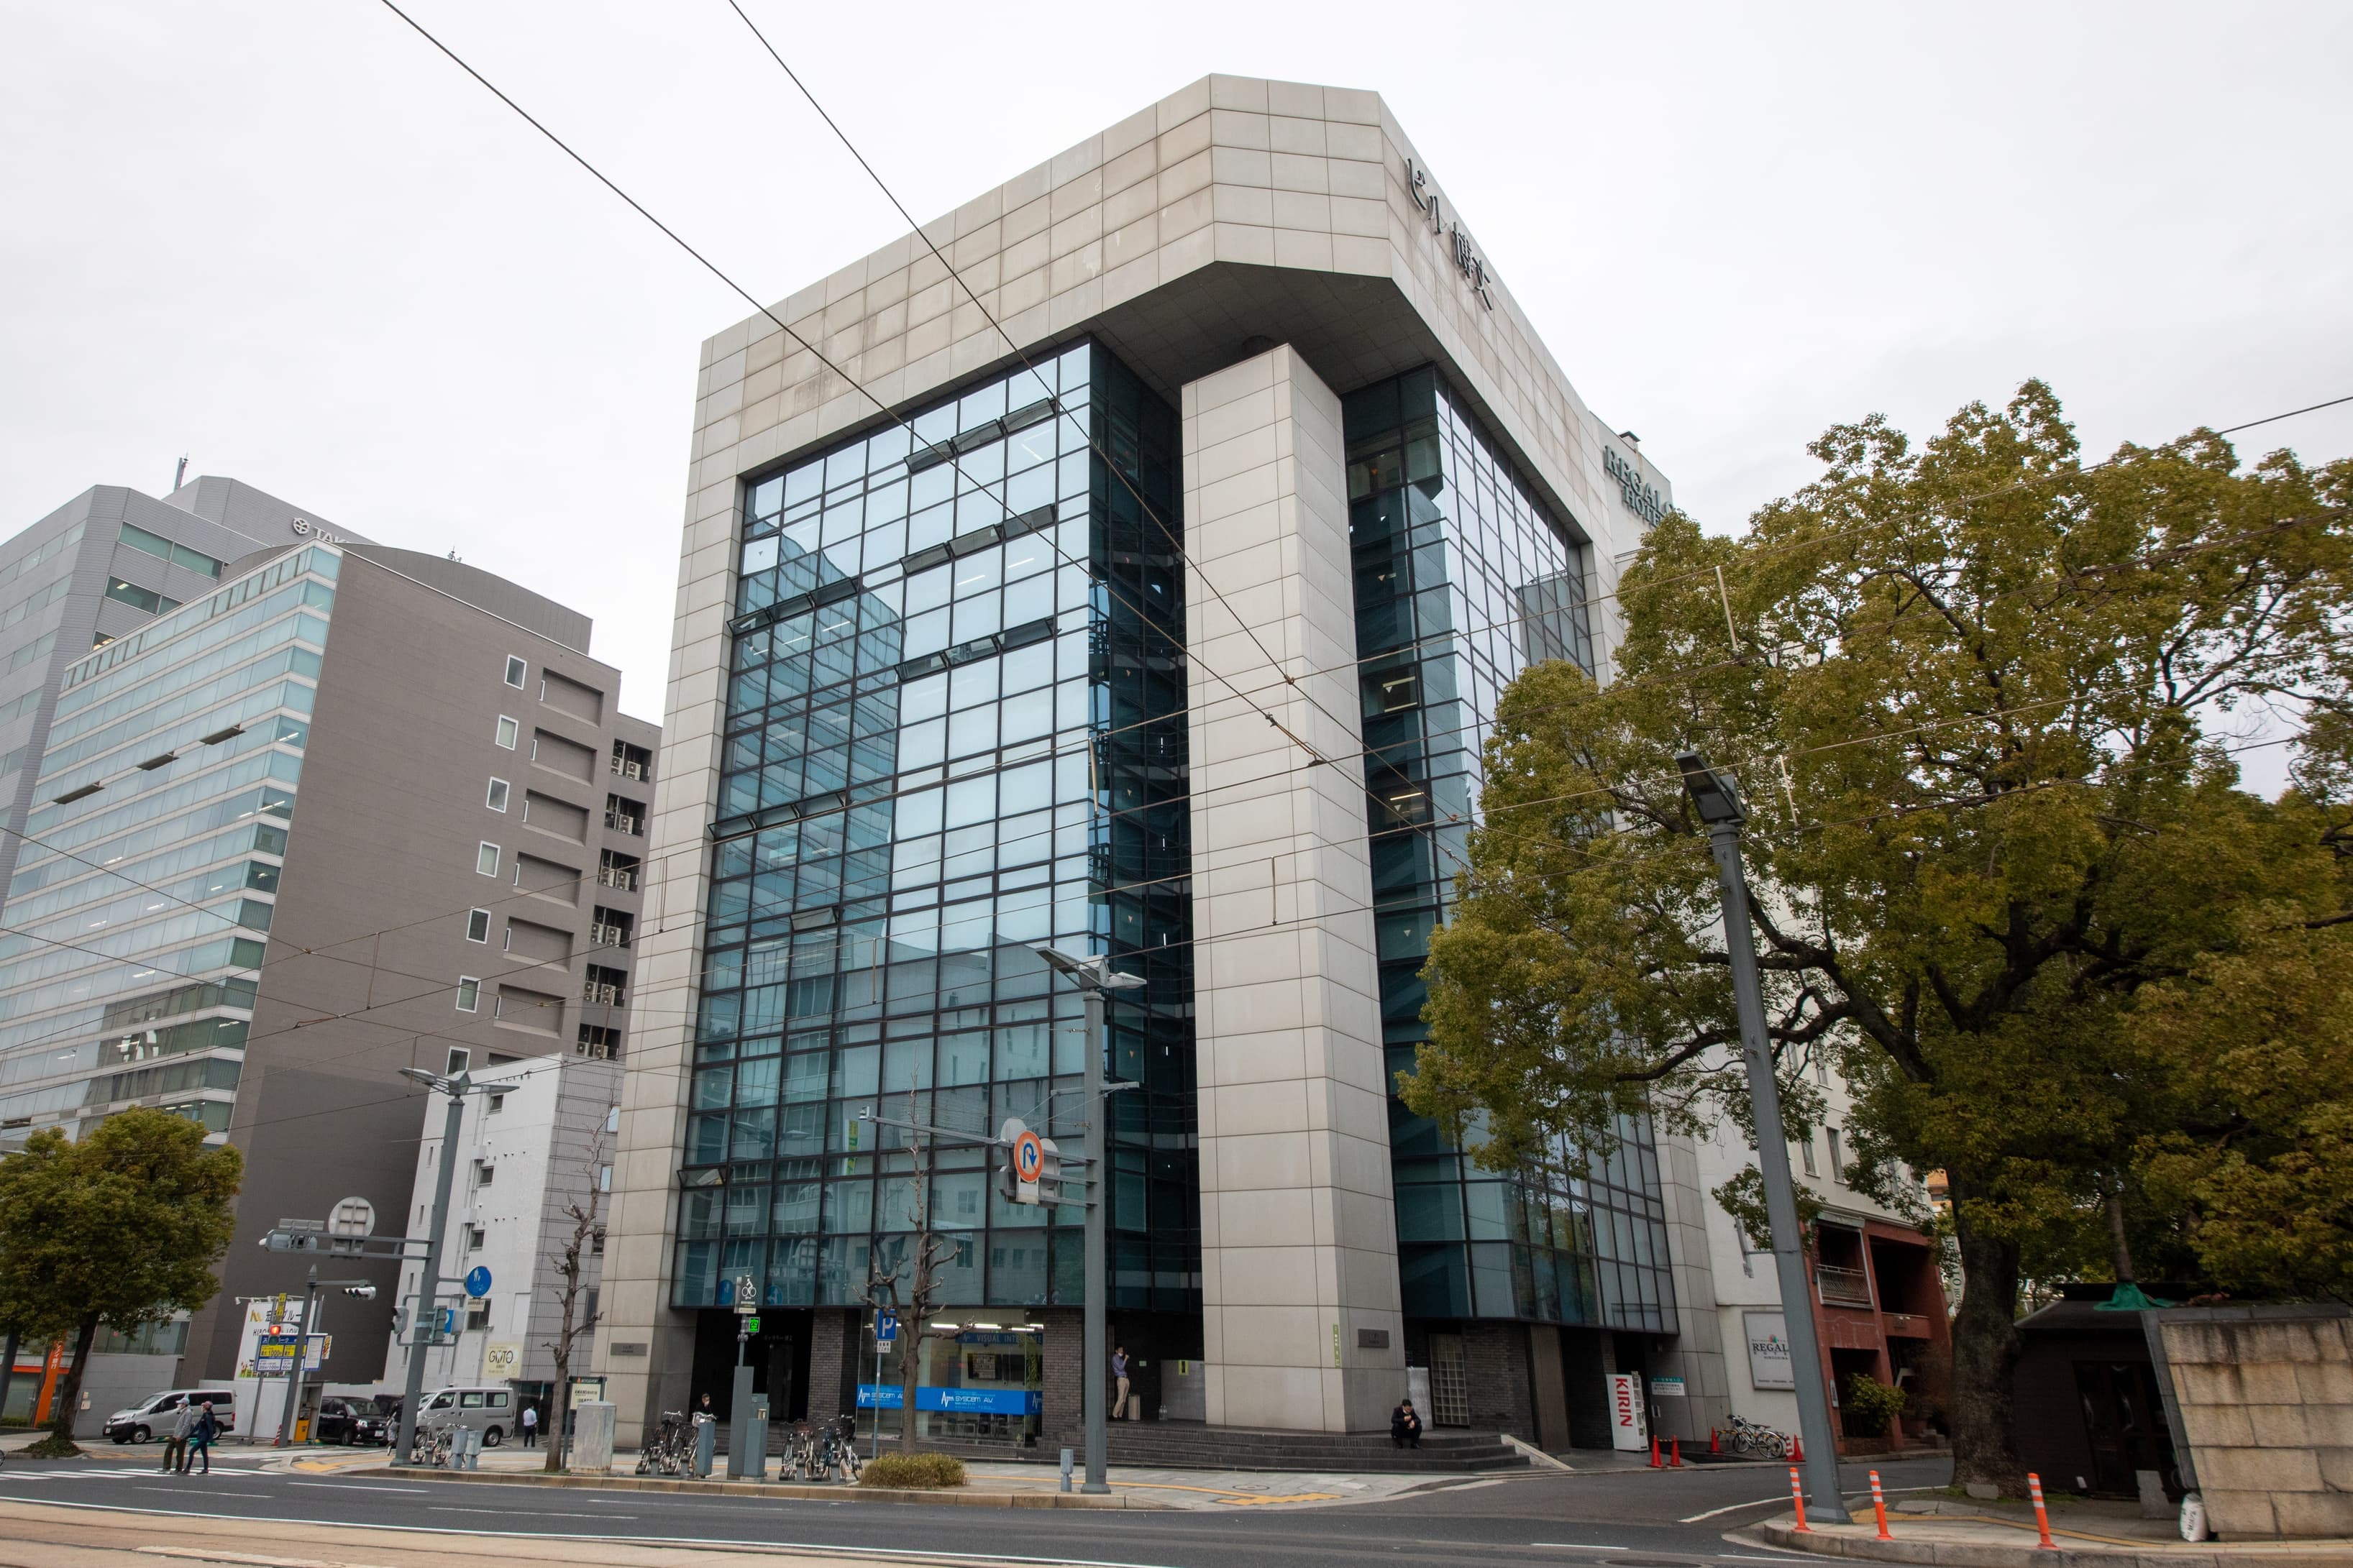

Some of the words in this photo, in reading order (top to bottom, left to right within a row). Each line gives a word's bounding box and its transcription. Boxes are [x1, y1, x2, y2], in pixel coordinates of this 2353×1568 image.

[1622, 485, 1661, 528] HOTE
[882, 1316, 894, 1337] P
[977, 1334, 1000, 1342] VISUAL
[1752, 1342, 1789, 1352] REGAL
[1615, 1377, 1633, 1427] KIRIN
